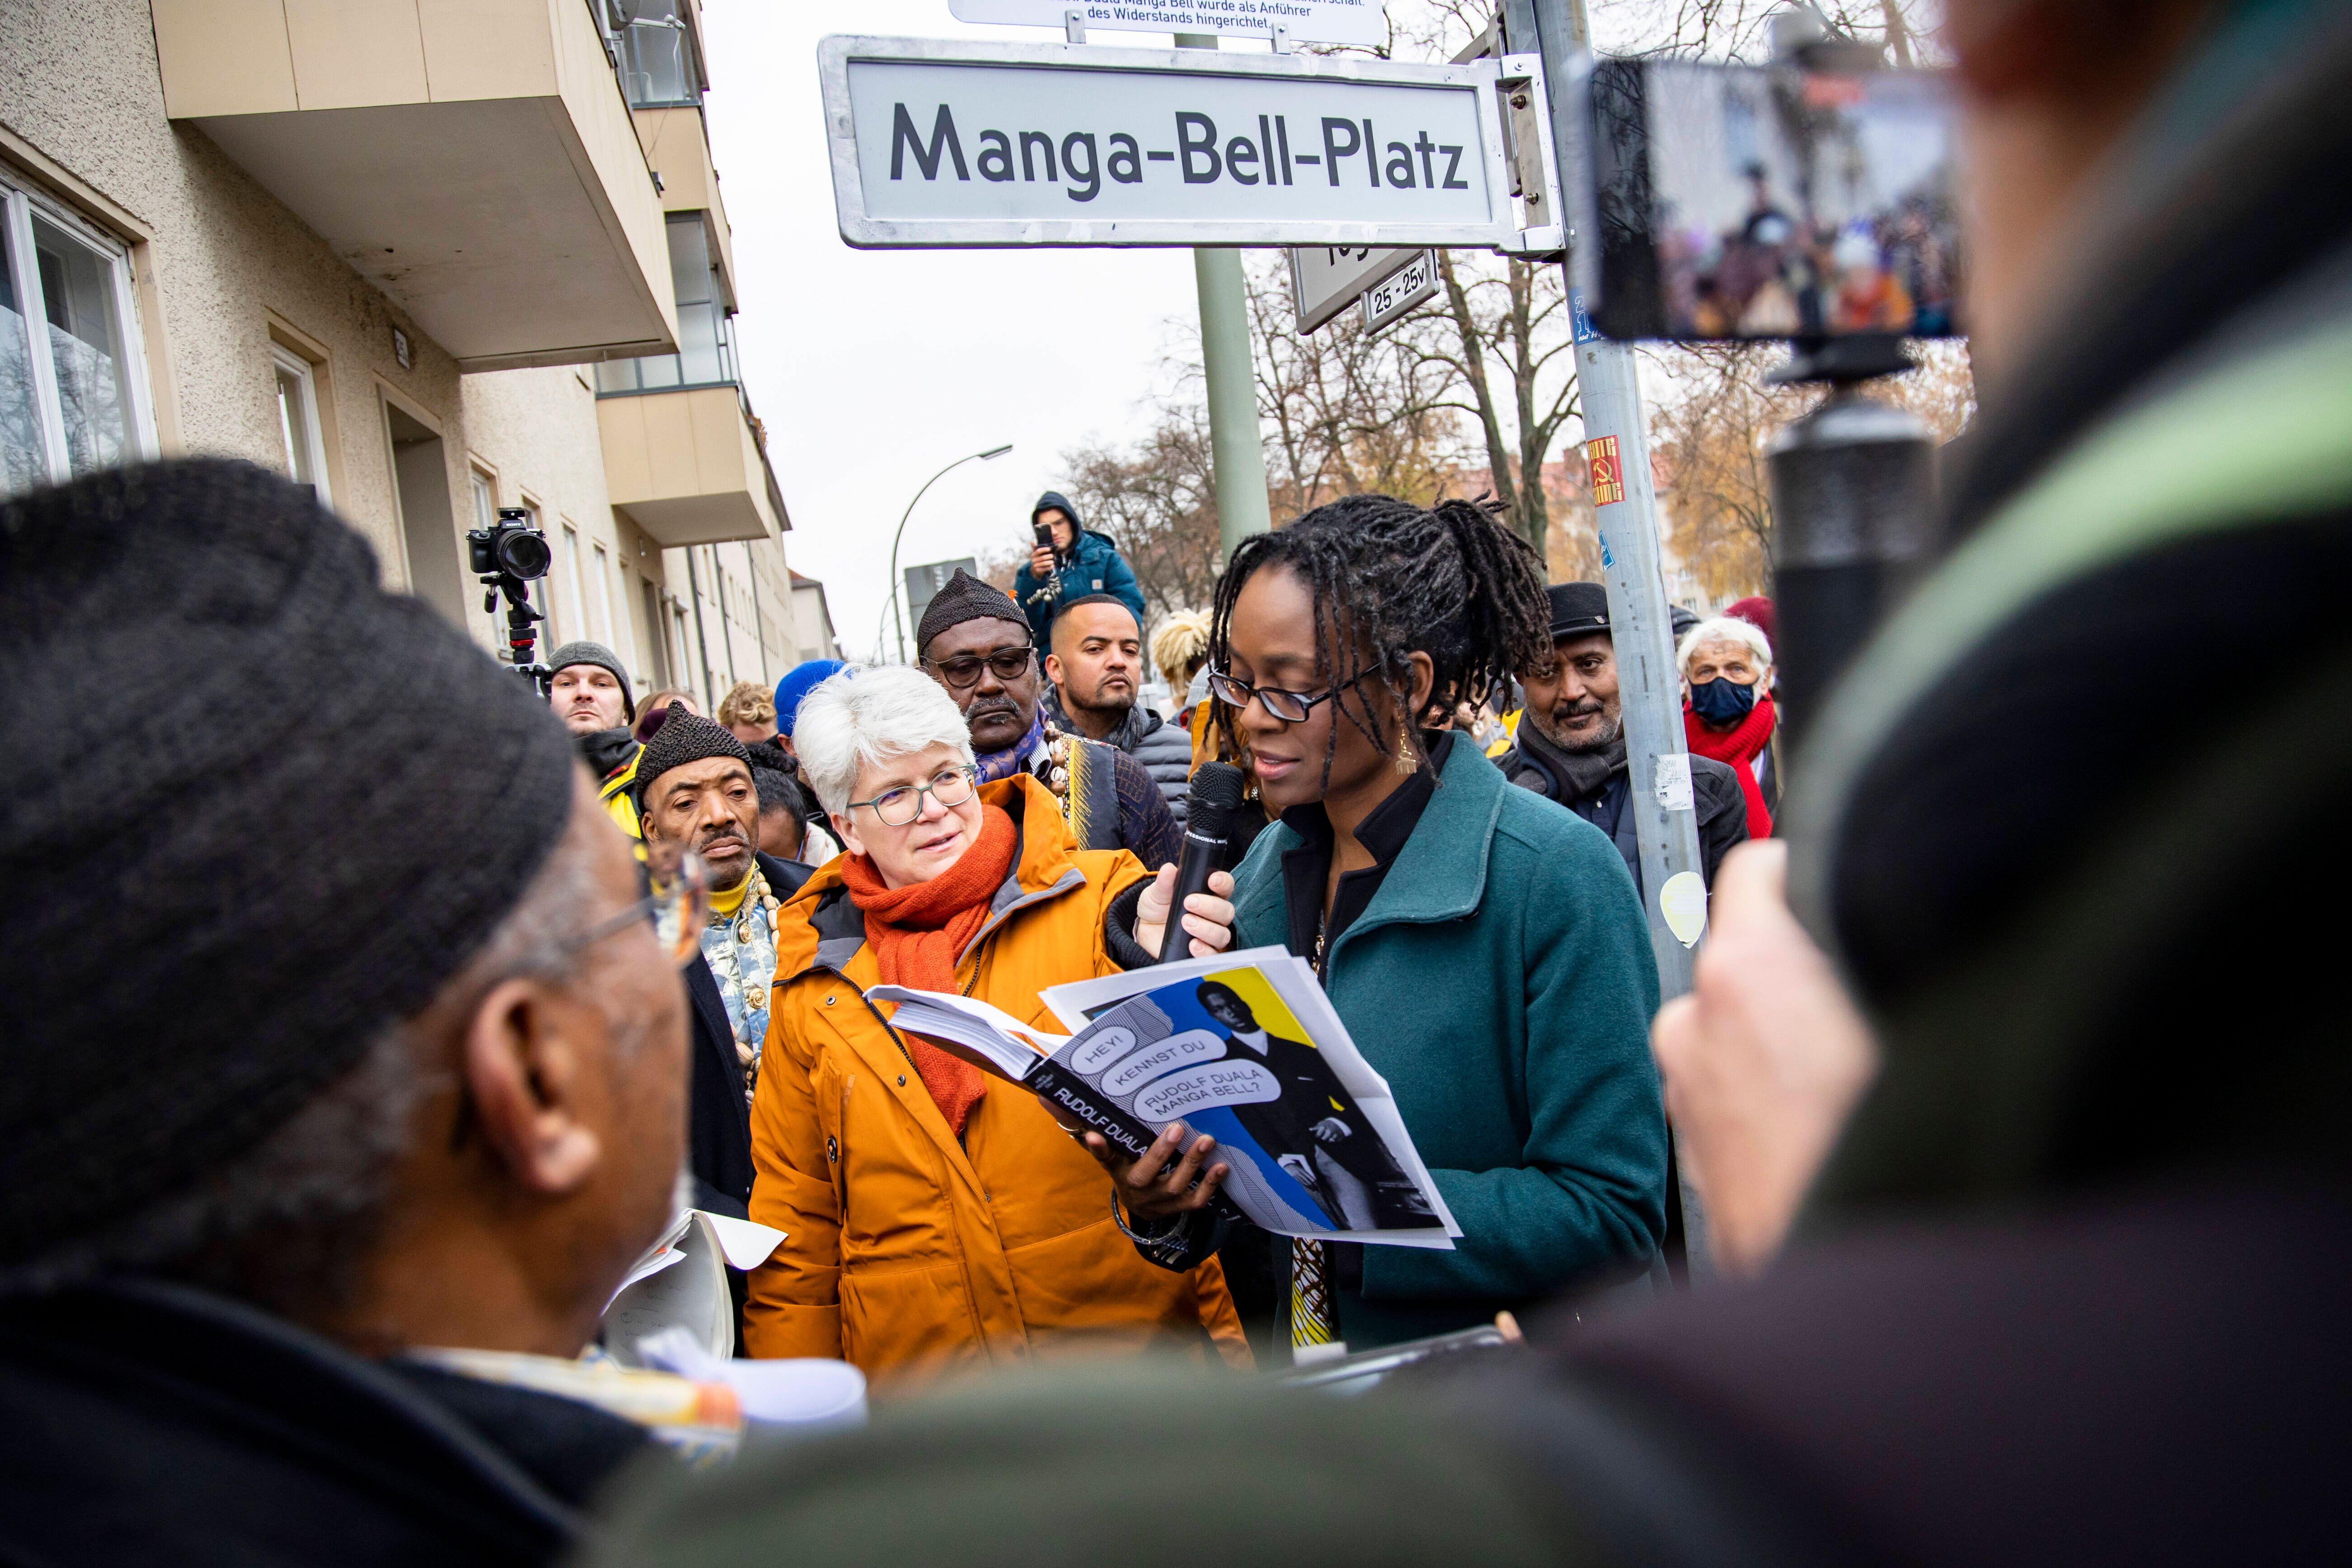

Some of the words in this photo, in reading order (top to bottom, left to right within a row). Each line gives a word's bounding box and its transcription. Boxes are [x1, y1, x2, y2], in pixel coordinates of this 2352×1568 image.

[1088, 6, 1110, 19] des
[1114, 7, 1193, 23] Widerstands
[1196, 12, 1271, 28] hingerichtet.
[1197, 0, 1235, 10] wurde
[1239, 0, 1256, 12] als
[1260, 2, 1311, 16] Anführer
[890, 102, 1468, 202] Manga-Bell-Platz
[1375, 286, 1391, 314] 25
[1403, 267, 1424, 296] 25v
[1114, 1047, 1179, 1086] KENNST
[1180, 1040, 1206, 1054] DU
[1145, 1076, 1207, 1108] RUDOLF
[1212, 1069, 1263, 1084] DUALA
[1155, 1090, 1212, 1116] MANGA
[1213, 1081, 1261, 1096] BELL?
[1053, 1087, 1110, 1126] RUDOLF
[1104, 1123, 1148, 1157] DUALA
